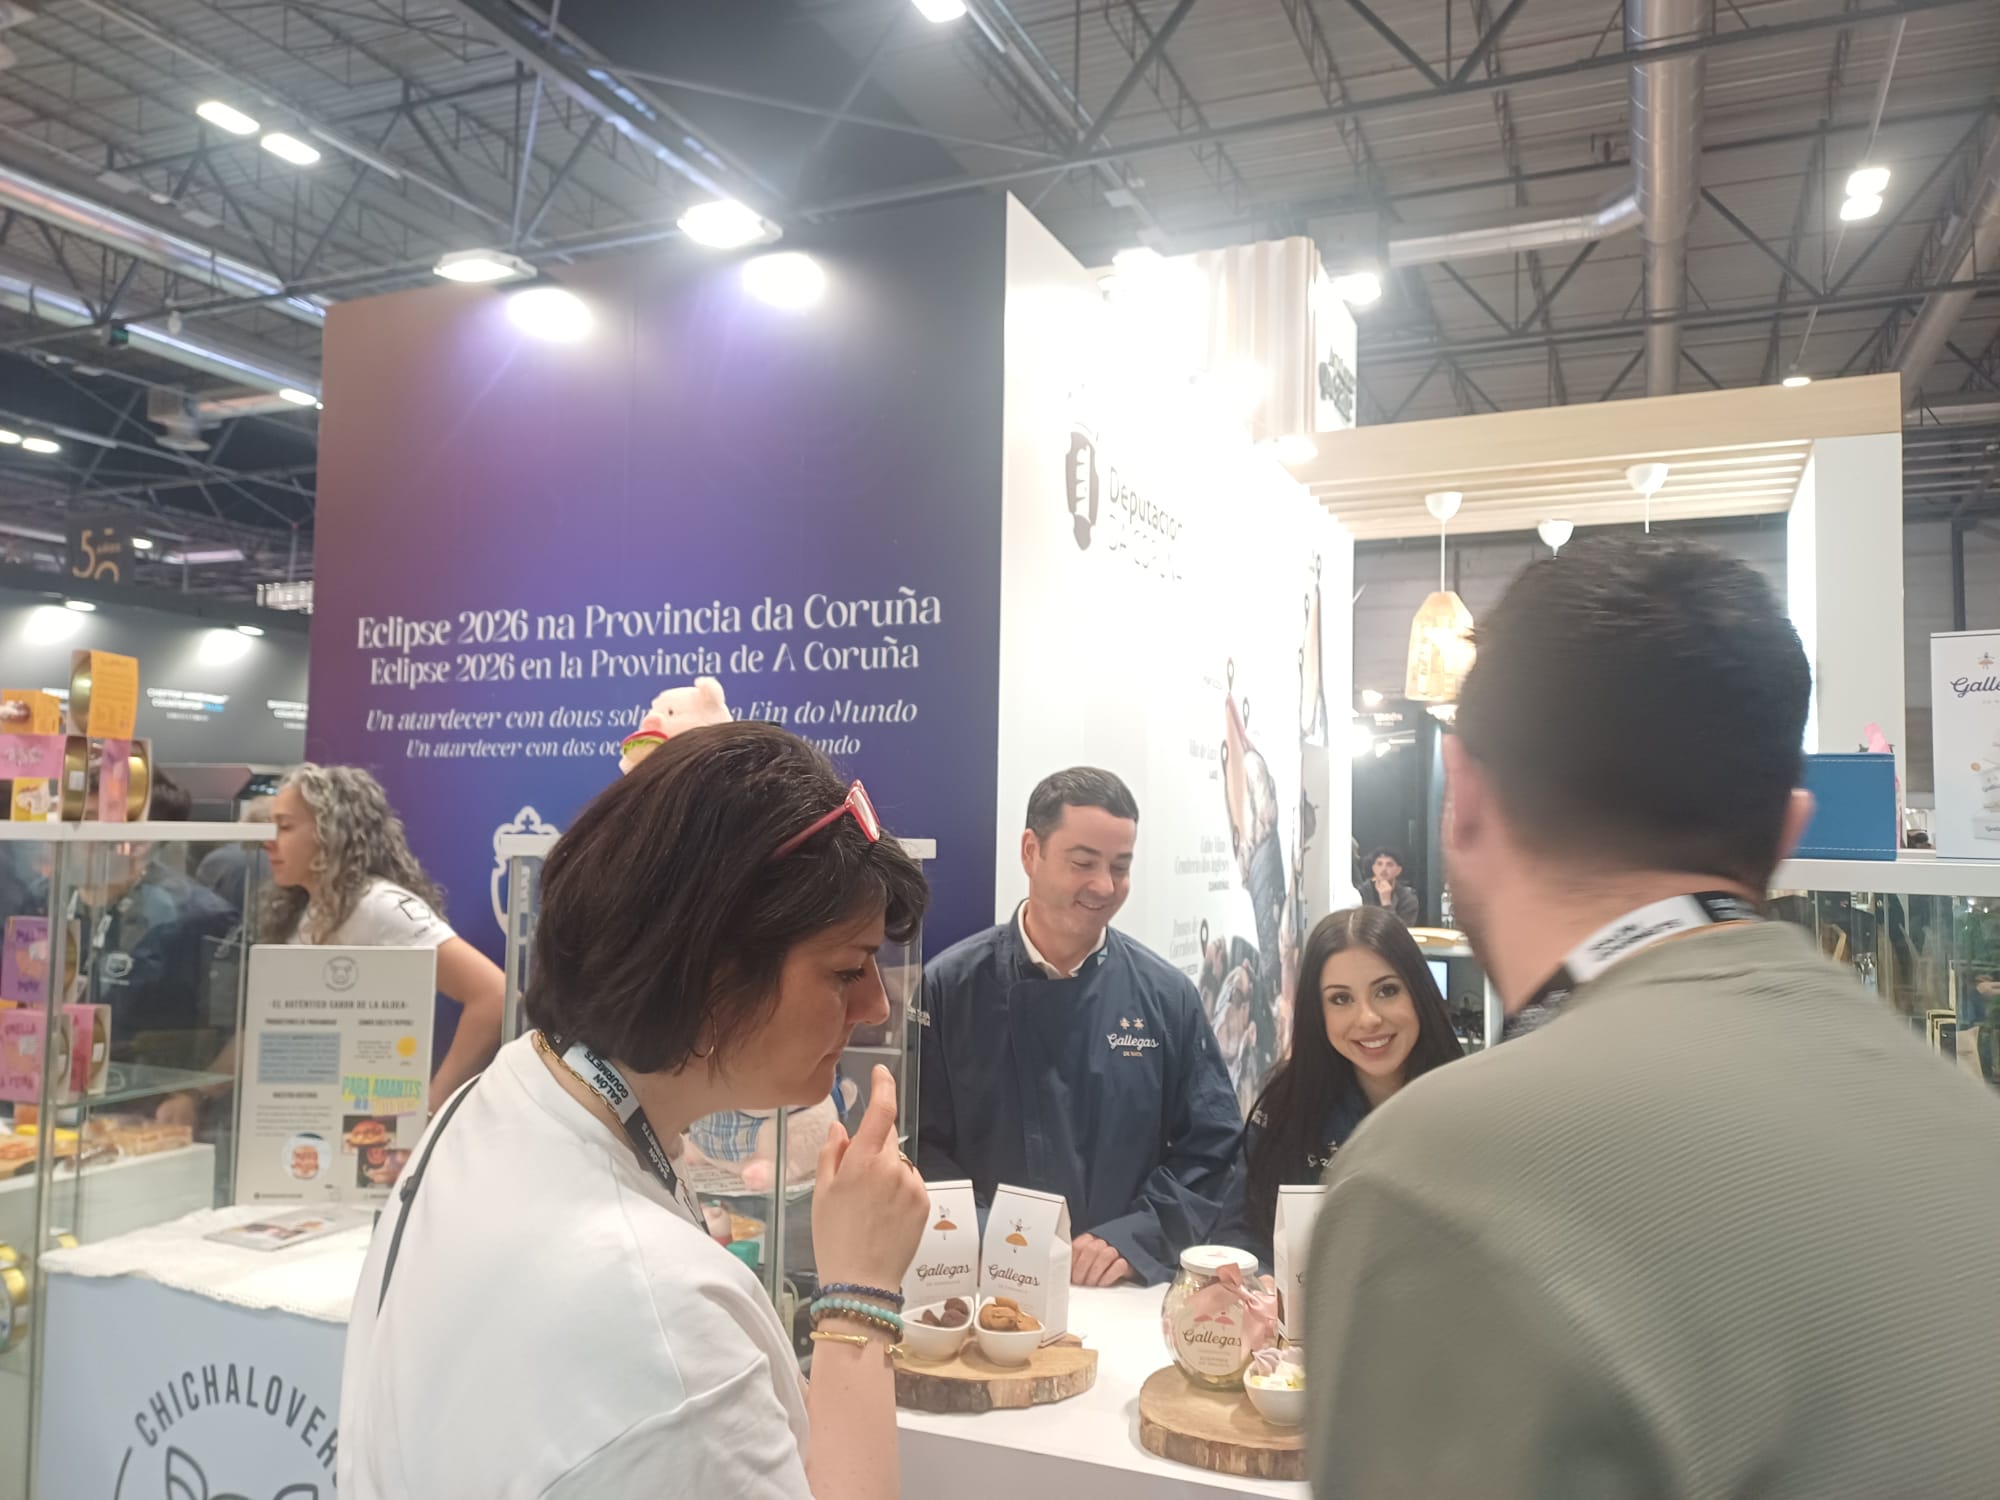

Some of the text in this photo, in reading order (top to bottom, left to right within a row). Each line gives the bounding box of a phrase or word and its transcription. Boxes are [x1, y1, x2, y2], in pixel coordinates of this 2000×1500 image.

[357, 586, 941, 654] Eclipse 2026 na Provincia da Coruña
[371, 636, 919, 690] Eclipse 2026 en la Provincia de A Coruña
[366, 709, 394, 732] Un
[398, 709, 502, 731] atardecer
[505, 709, 544, 729] con
[549, 706, 602, 729] dous
[749, 701, 788, 724] Fin
[794, 701, 825, 724] do
[829, 699, 918, 723] Mundo
[406, 739, 430, 758] Un
[433, 739, 522, 758] atardecer
[525, 739, 559, 757] con
[562, 738, 596, 757] dos
[802, 735, 861, 755] undo
[1106, 1033, 1159, 1051] Gallegas
[584, 1050, 629, 1099] GOURMETS
[593, 1074, 623, 1106] SALÓN
[916, 1263, 970, 1281] Gallegas
[988, 1264, 1040, 1287] Gallegas
[1182, 1328, 1242, 1348] Gallegas
[134, 1363, 338, 1489] CHICHALOVER
